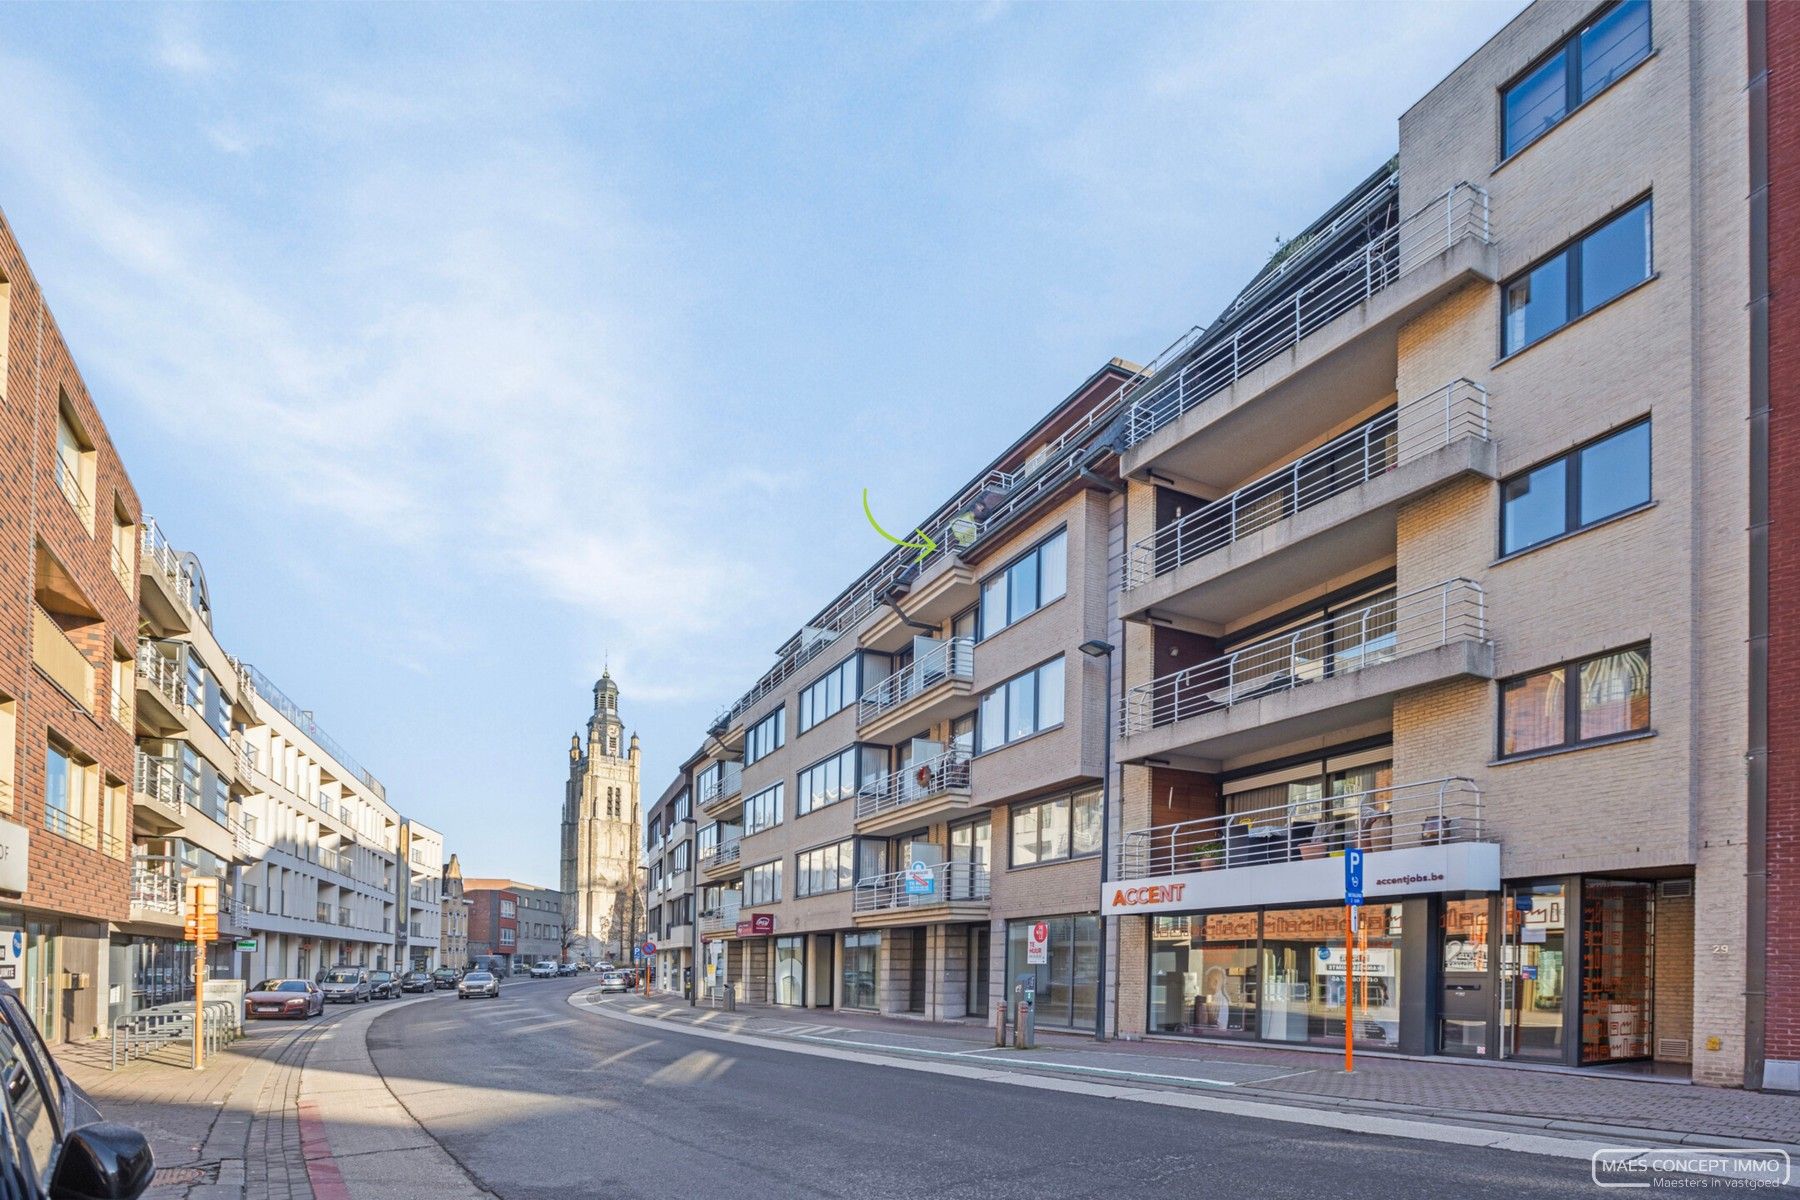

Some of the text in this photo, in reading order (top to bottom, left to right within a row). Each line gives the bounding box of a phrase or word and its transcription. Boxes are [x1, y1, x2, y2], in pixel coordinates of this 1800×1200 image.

[1350, 852, 1360, 874] P
[1376, 872, 1444, 886] accentjobs.be
[1112, 883, 1185, 907] ACCENT
[1712, 944, 1729, 954] 29
